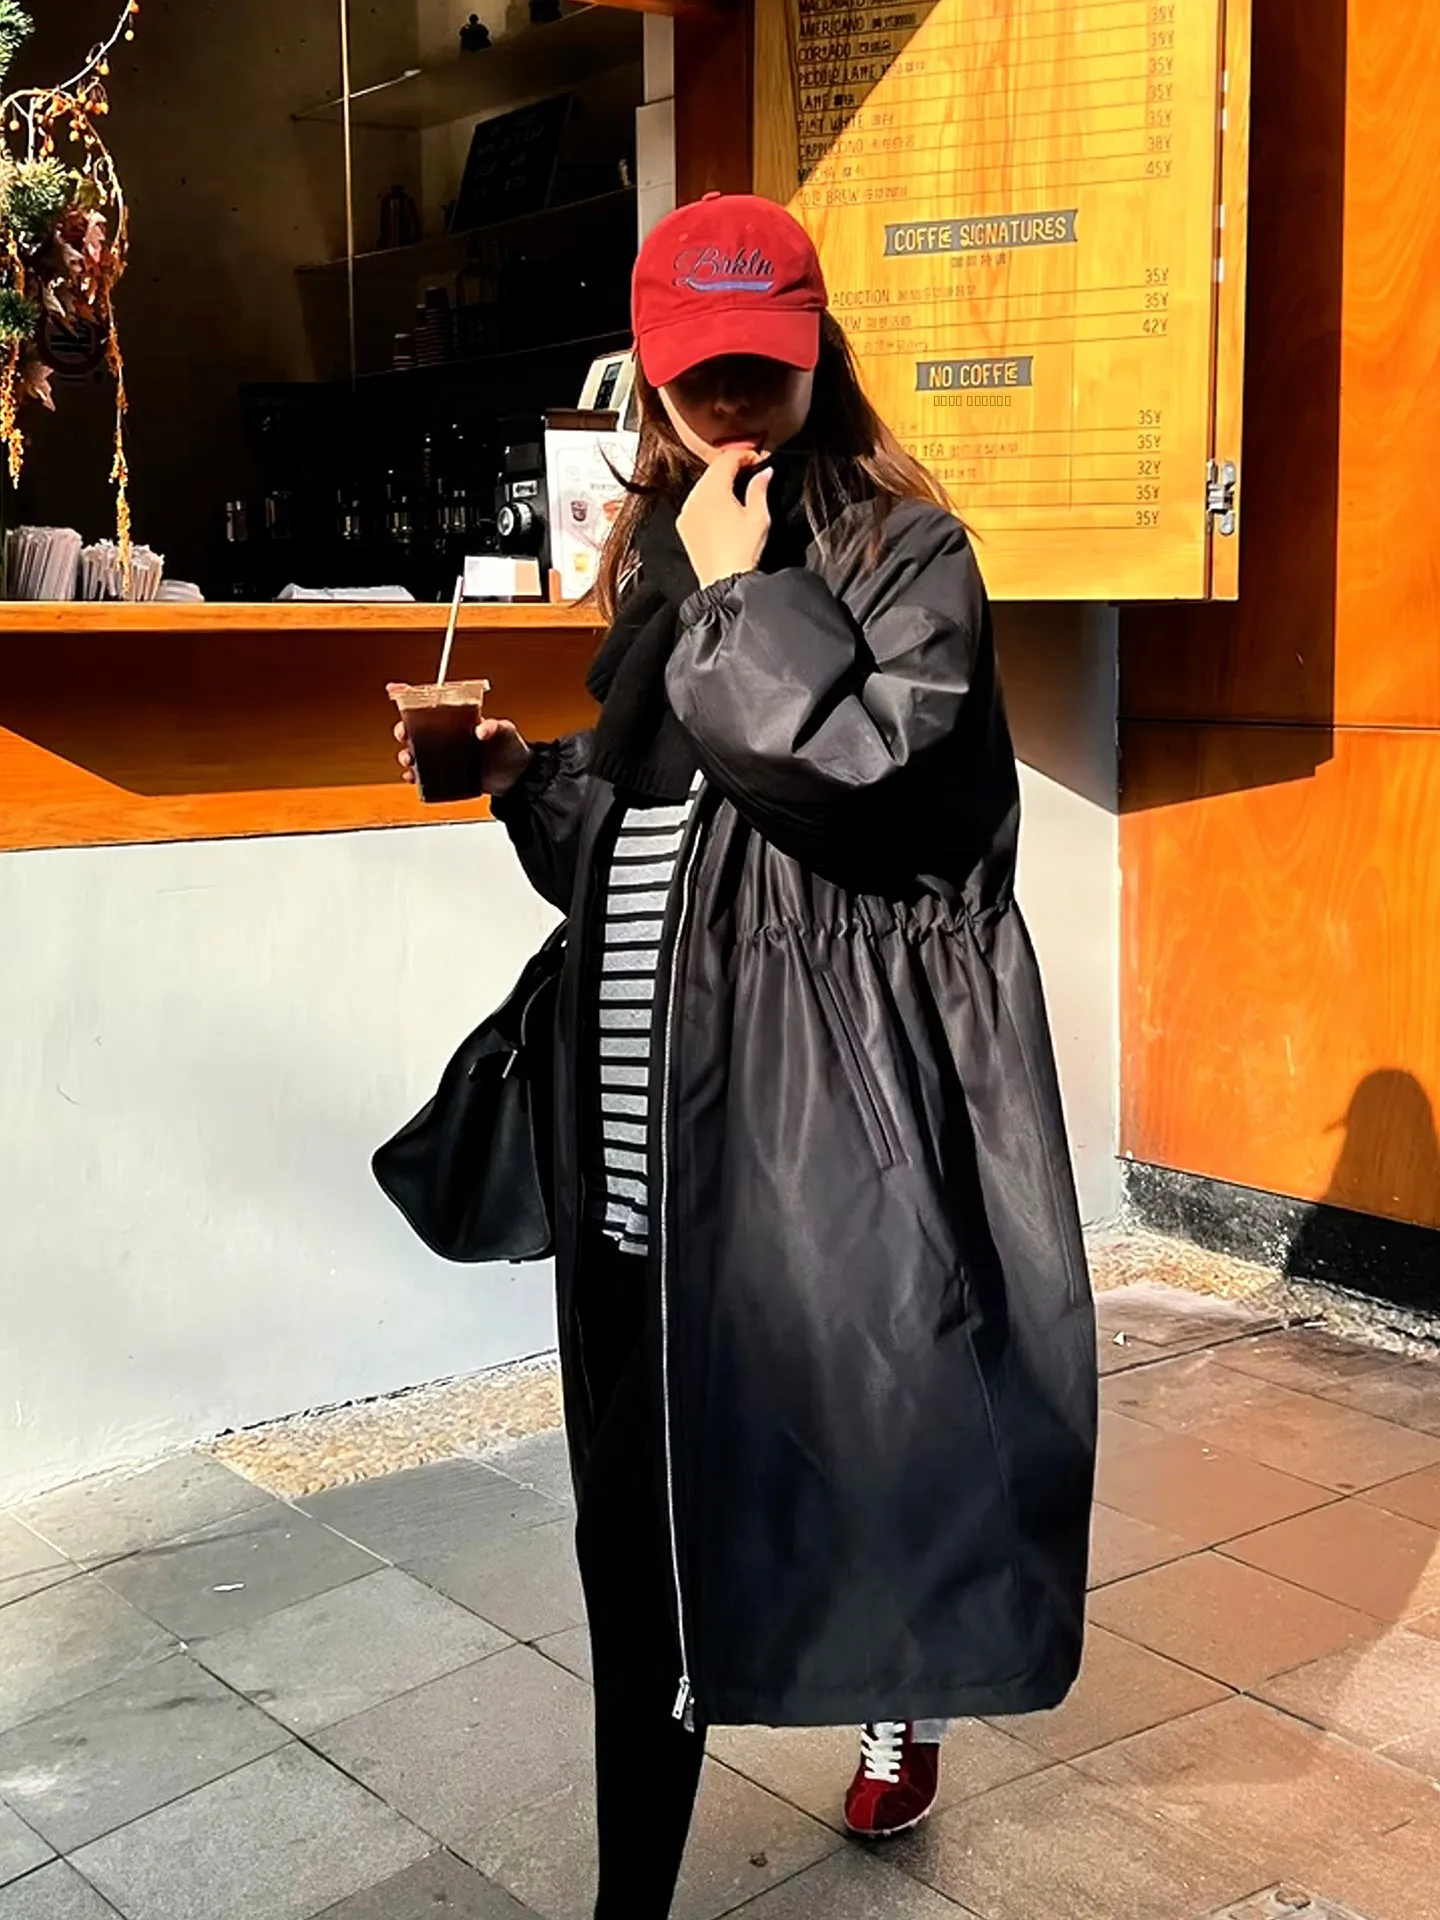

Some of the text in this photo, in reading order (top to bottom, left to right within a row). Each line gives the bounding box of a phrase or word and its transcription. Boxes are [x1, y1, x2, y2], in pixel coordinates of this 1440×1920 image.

[800, 16, 866, 37] AMERICANO
[959, 216, 1067, 248] SIGNATURES
[929, 366, 952, 388] NO
